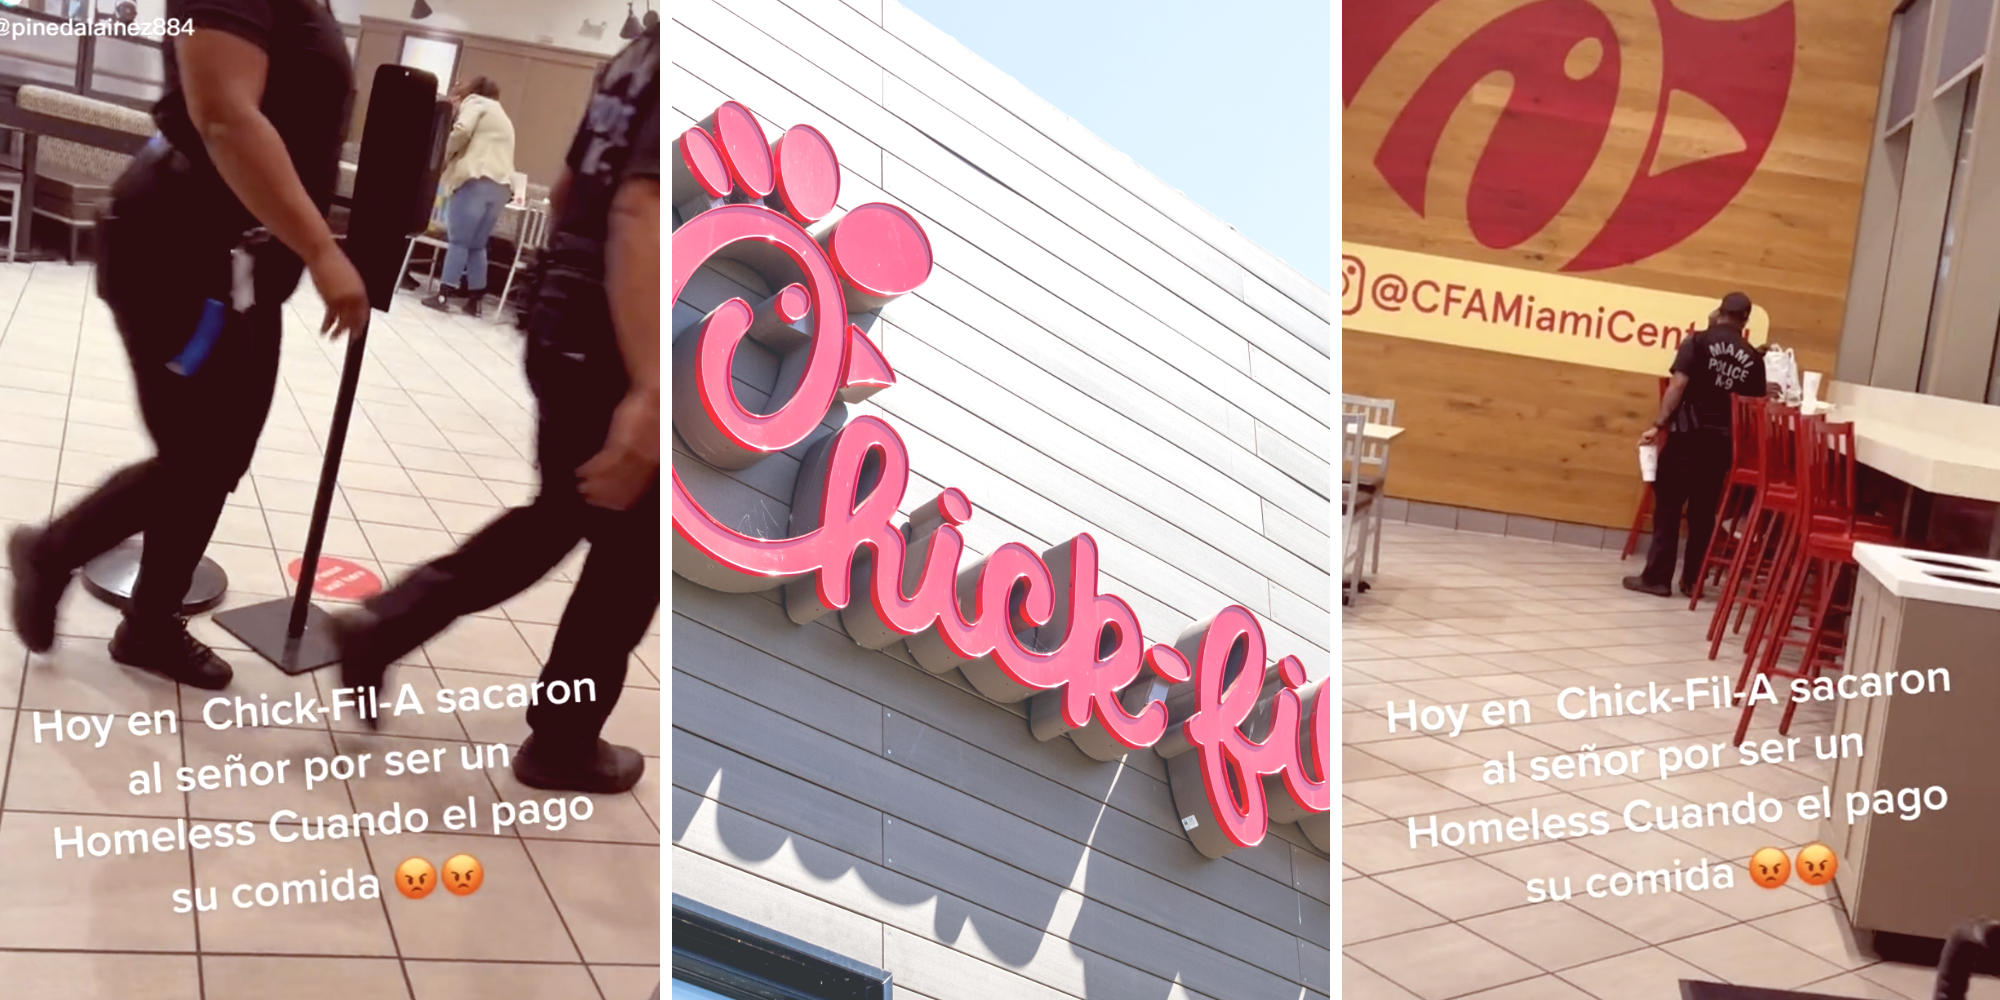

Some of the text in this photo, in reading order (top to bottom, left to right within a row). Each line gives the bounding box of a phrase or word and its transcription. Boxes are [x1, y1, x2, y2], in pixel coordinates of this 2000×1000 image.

[1371, 273, 1750, 351] @CFAMiamiCen
[1707, 357, 1750, 383] POLICE
[1708, 341, 1755, 369] MIAMI
[672, 203, 1330, 848] Chick-fi
